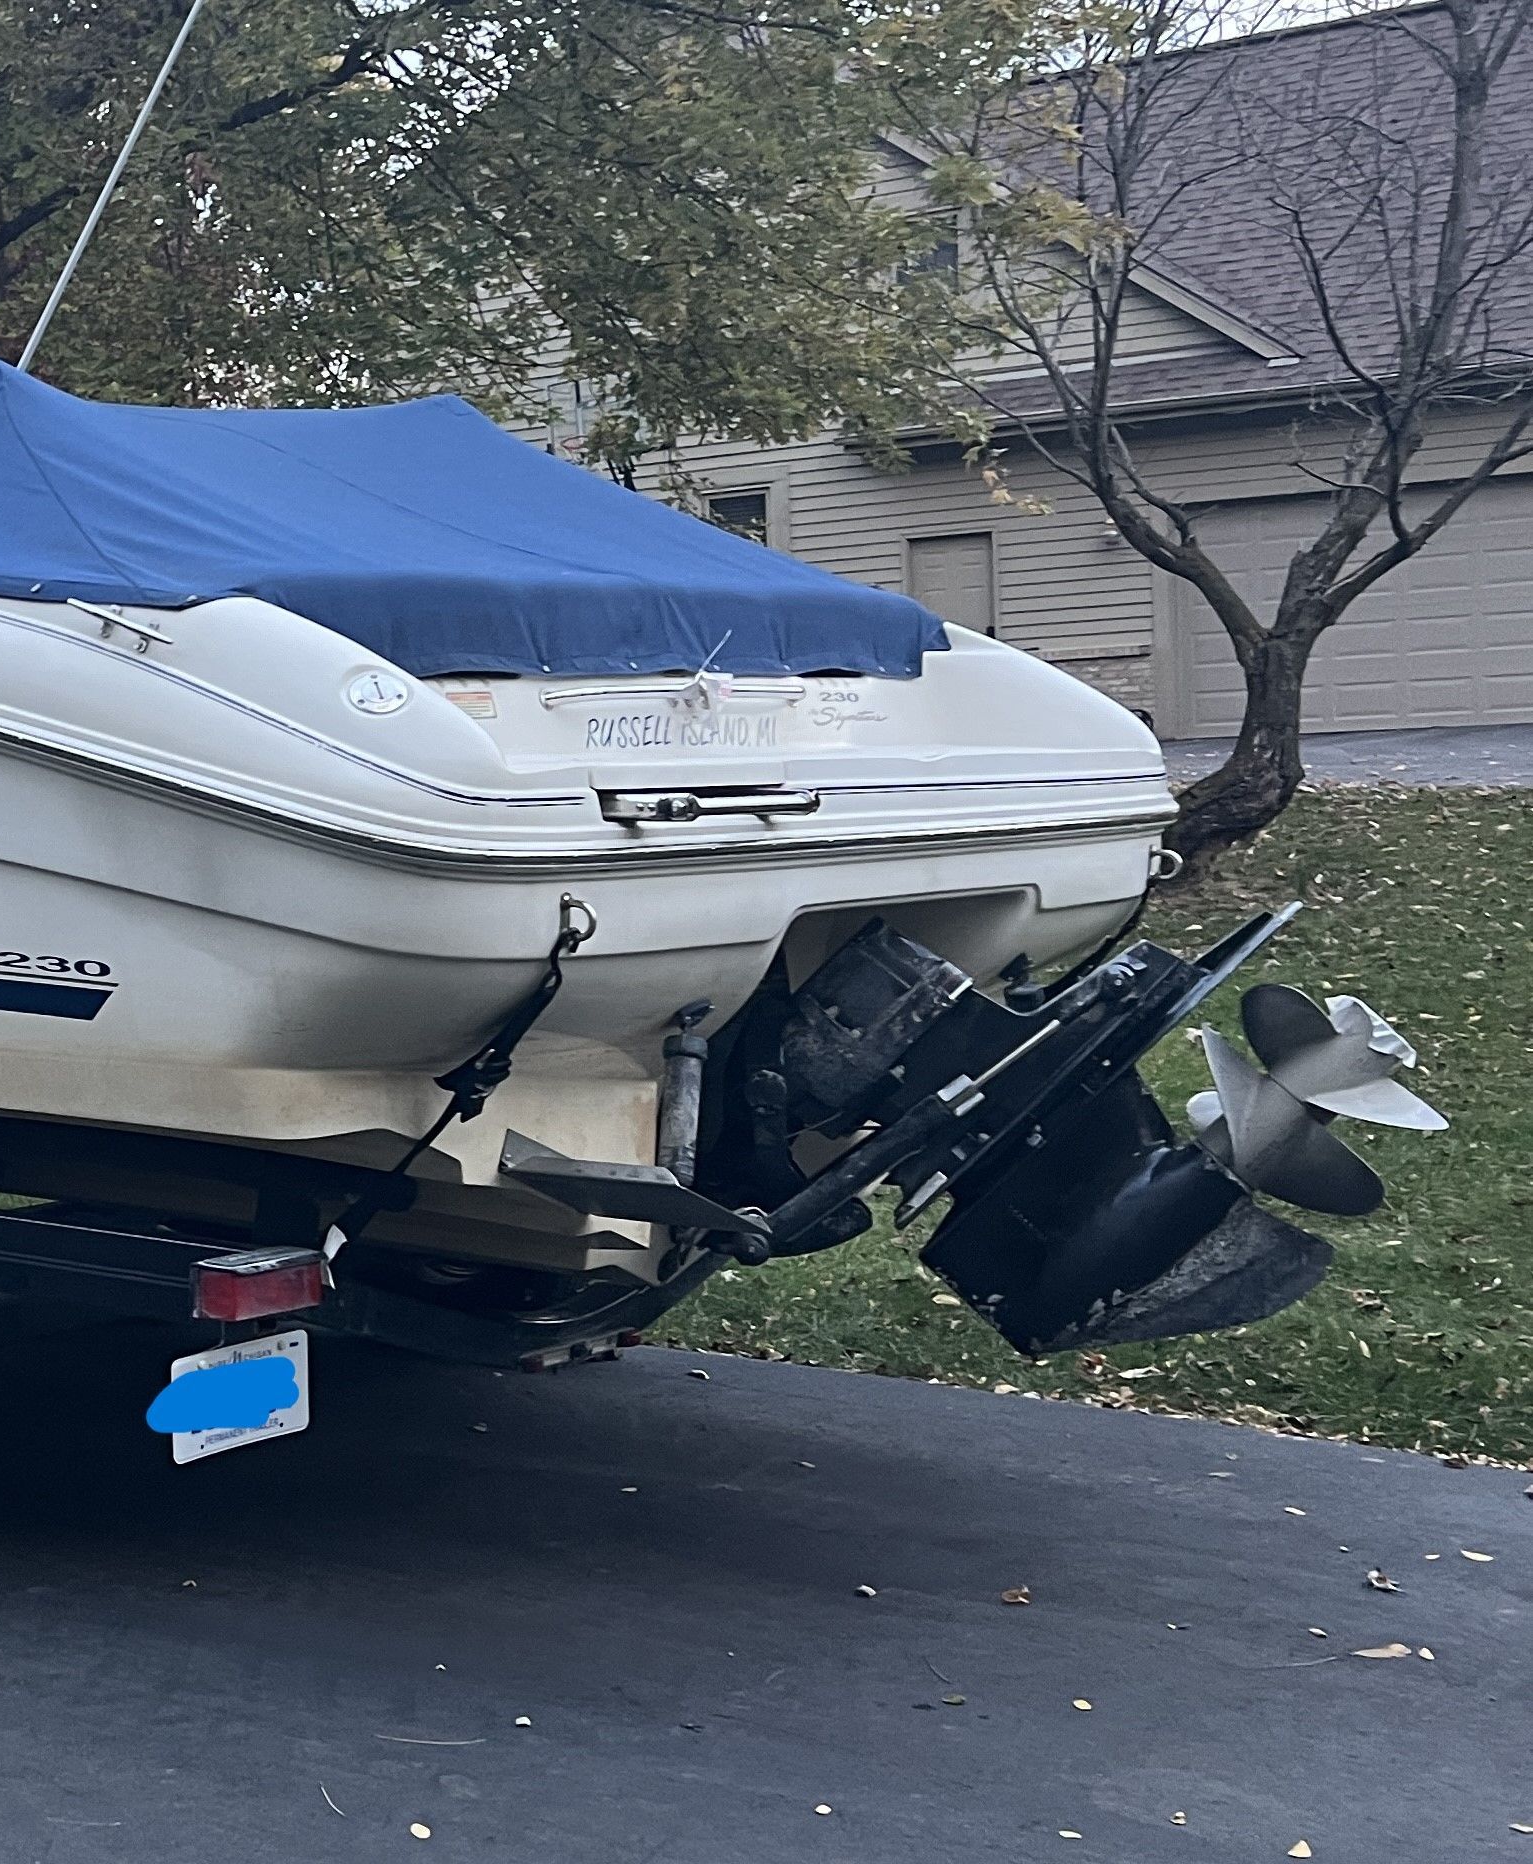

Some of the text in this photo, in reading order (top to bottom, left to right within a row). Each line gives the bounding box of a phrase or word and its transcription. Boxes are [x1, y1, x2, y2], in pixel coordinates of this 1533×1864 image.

[819, 691, 860, 703] 230
[586, 714, 672, 748] RUSSELL
[756, 716, 777, 747] MI
